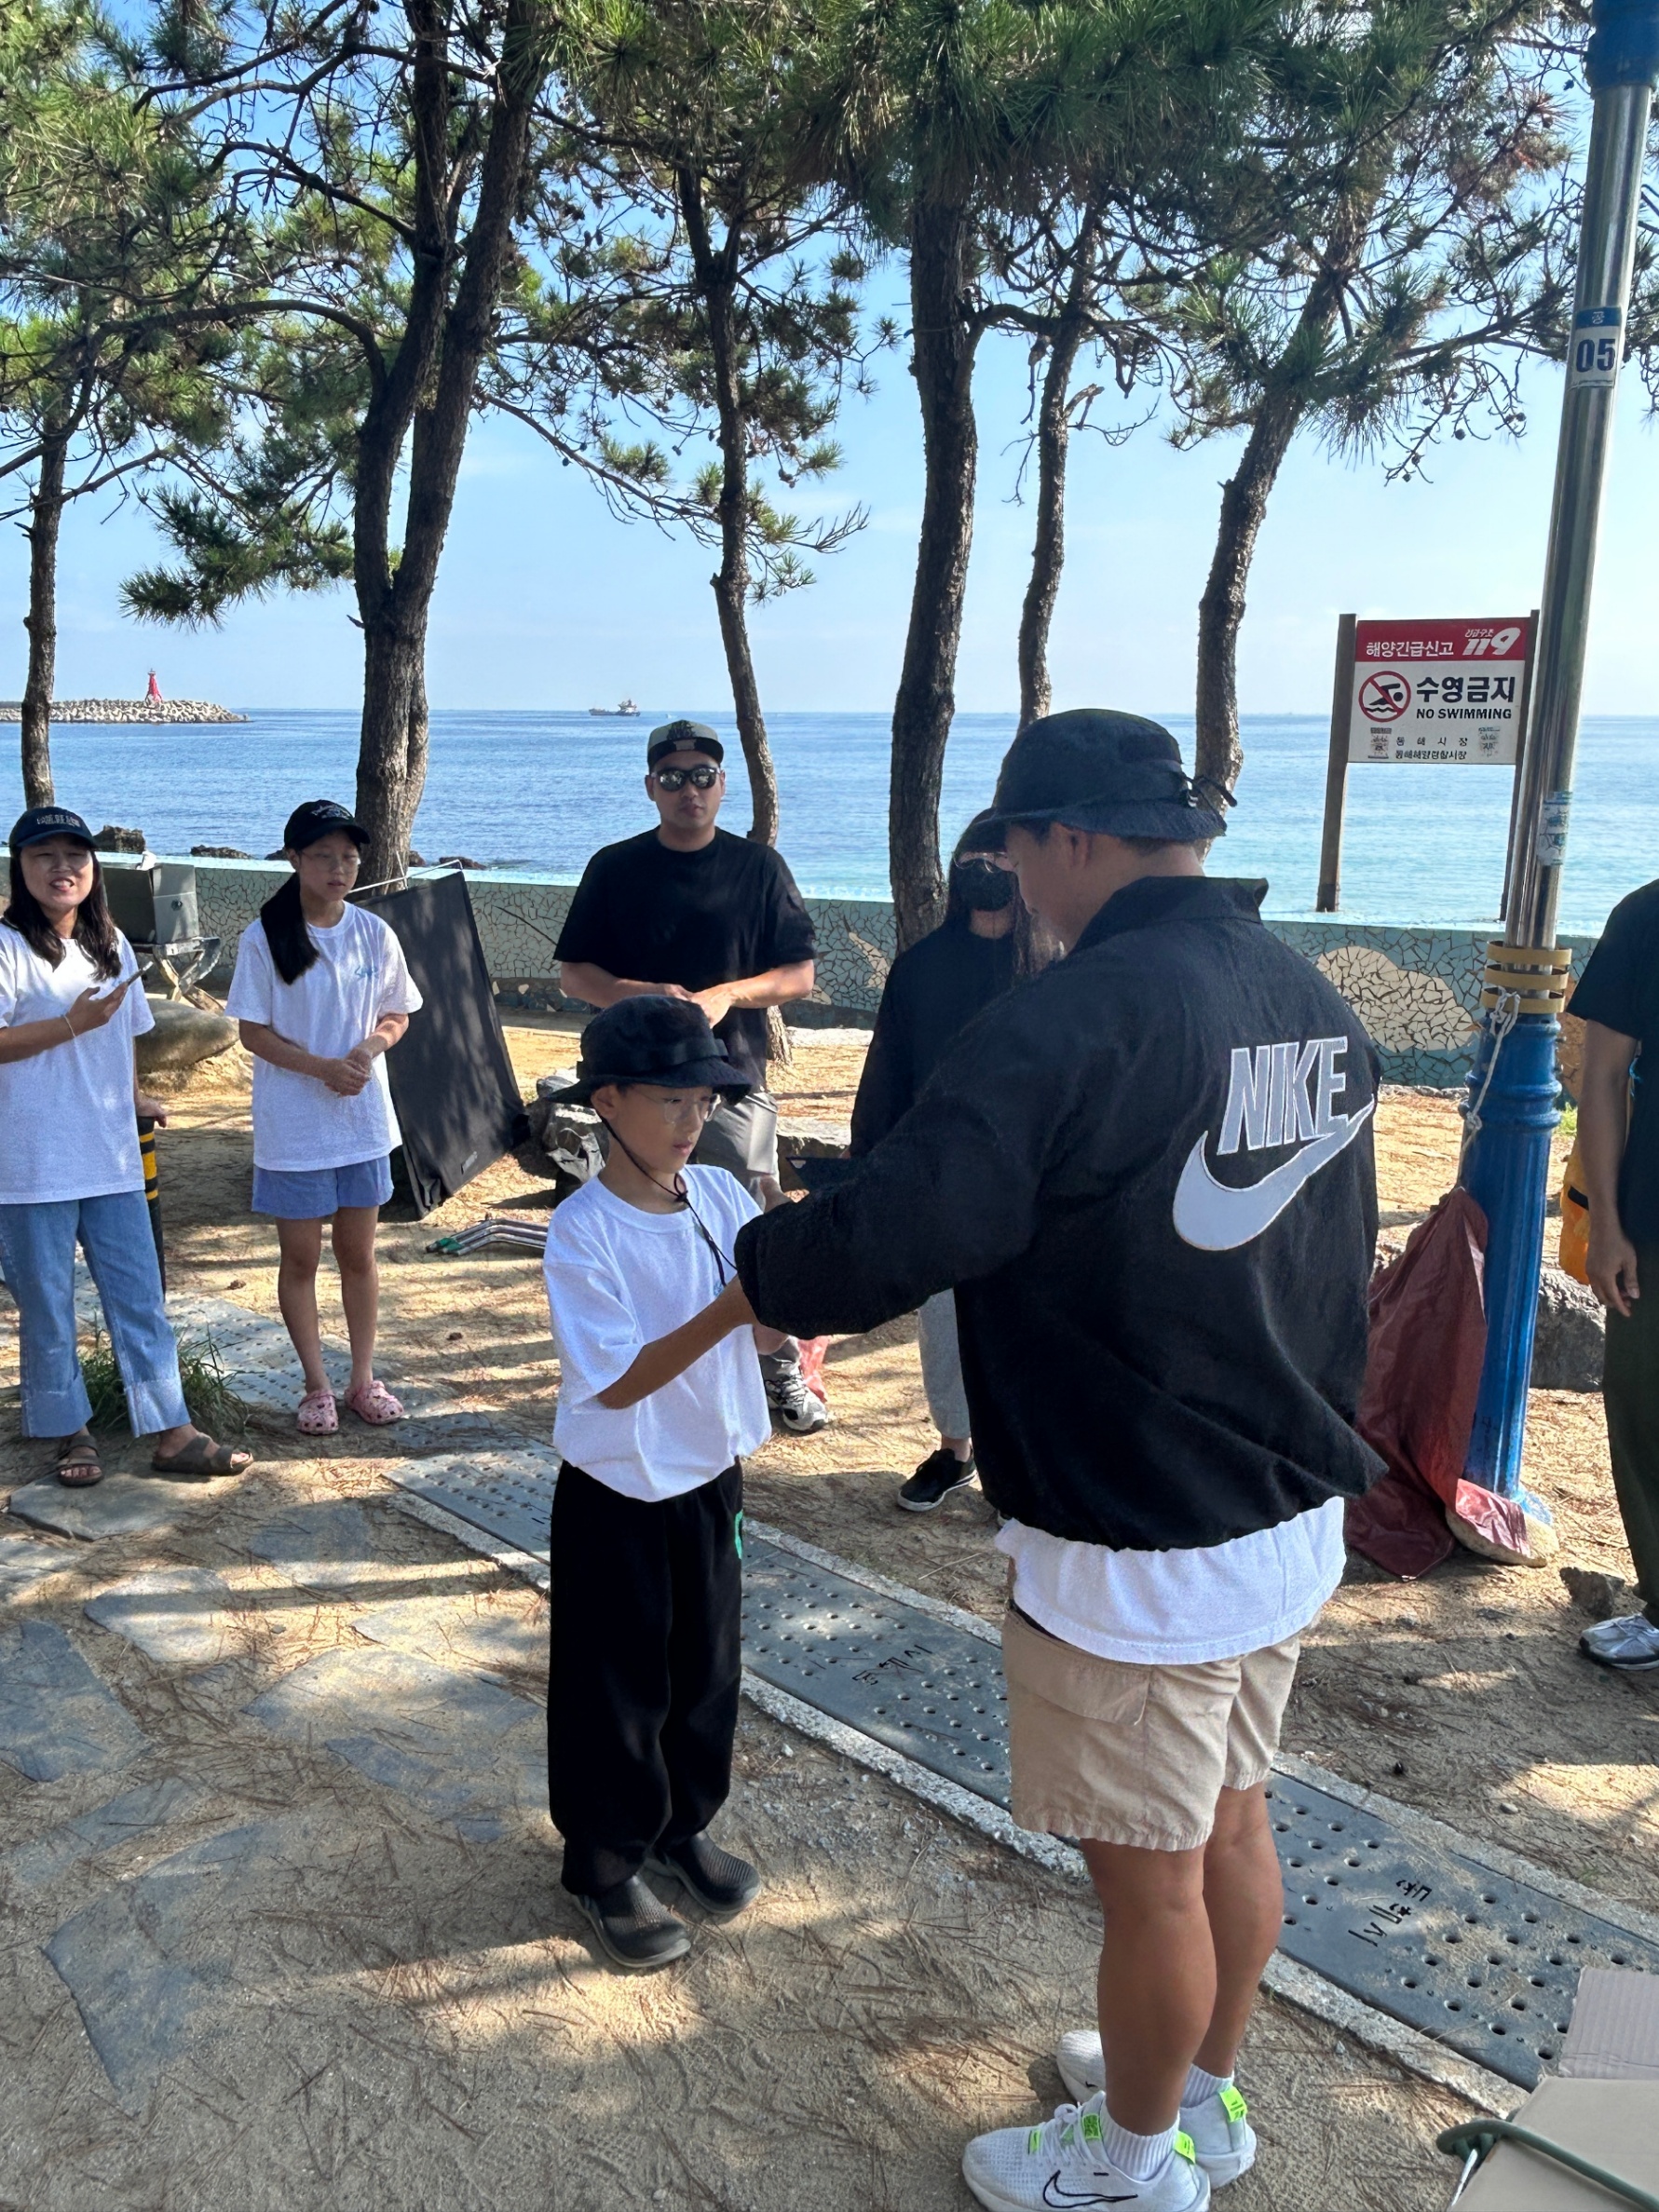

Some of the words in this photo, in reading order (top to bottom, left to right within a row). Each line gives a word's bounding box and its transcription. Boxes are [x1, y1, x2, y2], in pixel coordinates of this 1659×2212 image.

[1576, 338, 1616, 373] 05
[1366, 641, 1454, 658] 해양긴급신고
[1462, 627, 1521, 656] 119
[1416, 676, 1516, 703] 수영금지
[1416, 708, 1435, 719] NO
[1437, 708, 1512, 719] SWIMMING
[1217, 1036, 1348, 1156] NIKE
